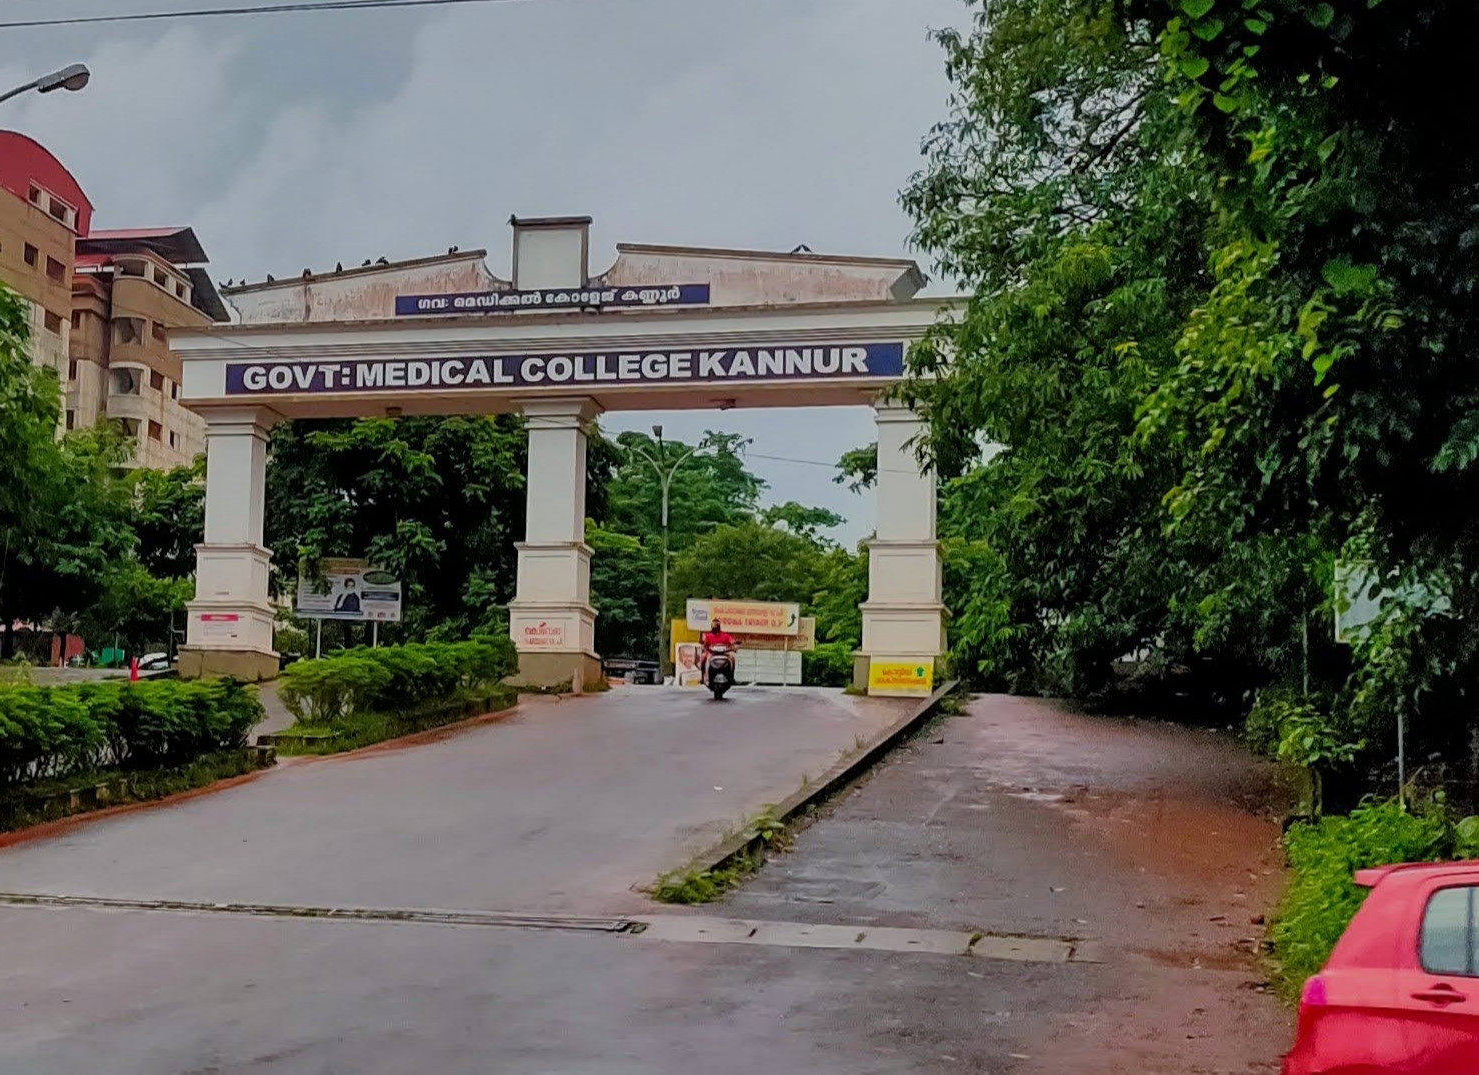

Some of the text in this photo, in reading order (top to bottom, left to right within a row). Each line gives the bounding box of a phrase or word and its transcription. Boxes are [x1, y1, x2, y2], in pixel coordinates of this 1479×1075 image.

[356, 359, 514, 388] MEDICAL
[521, 353, 692, 383] COLLEGE
[699, 348, 870, 378] KANNUR
